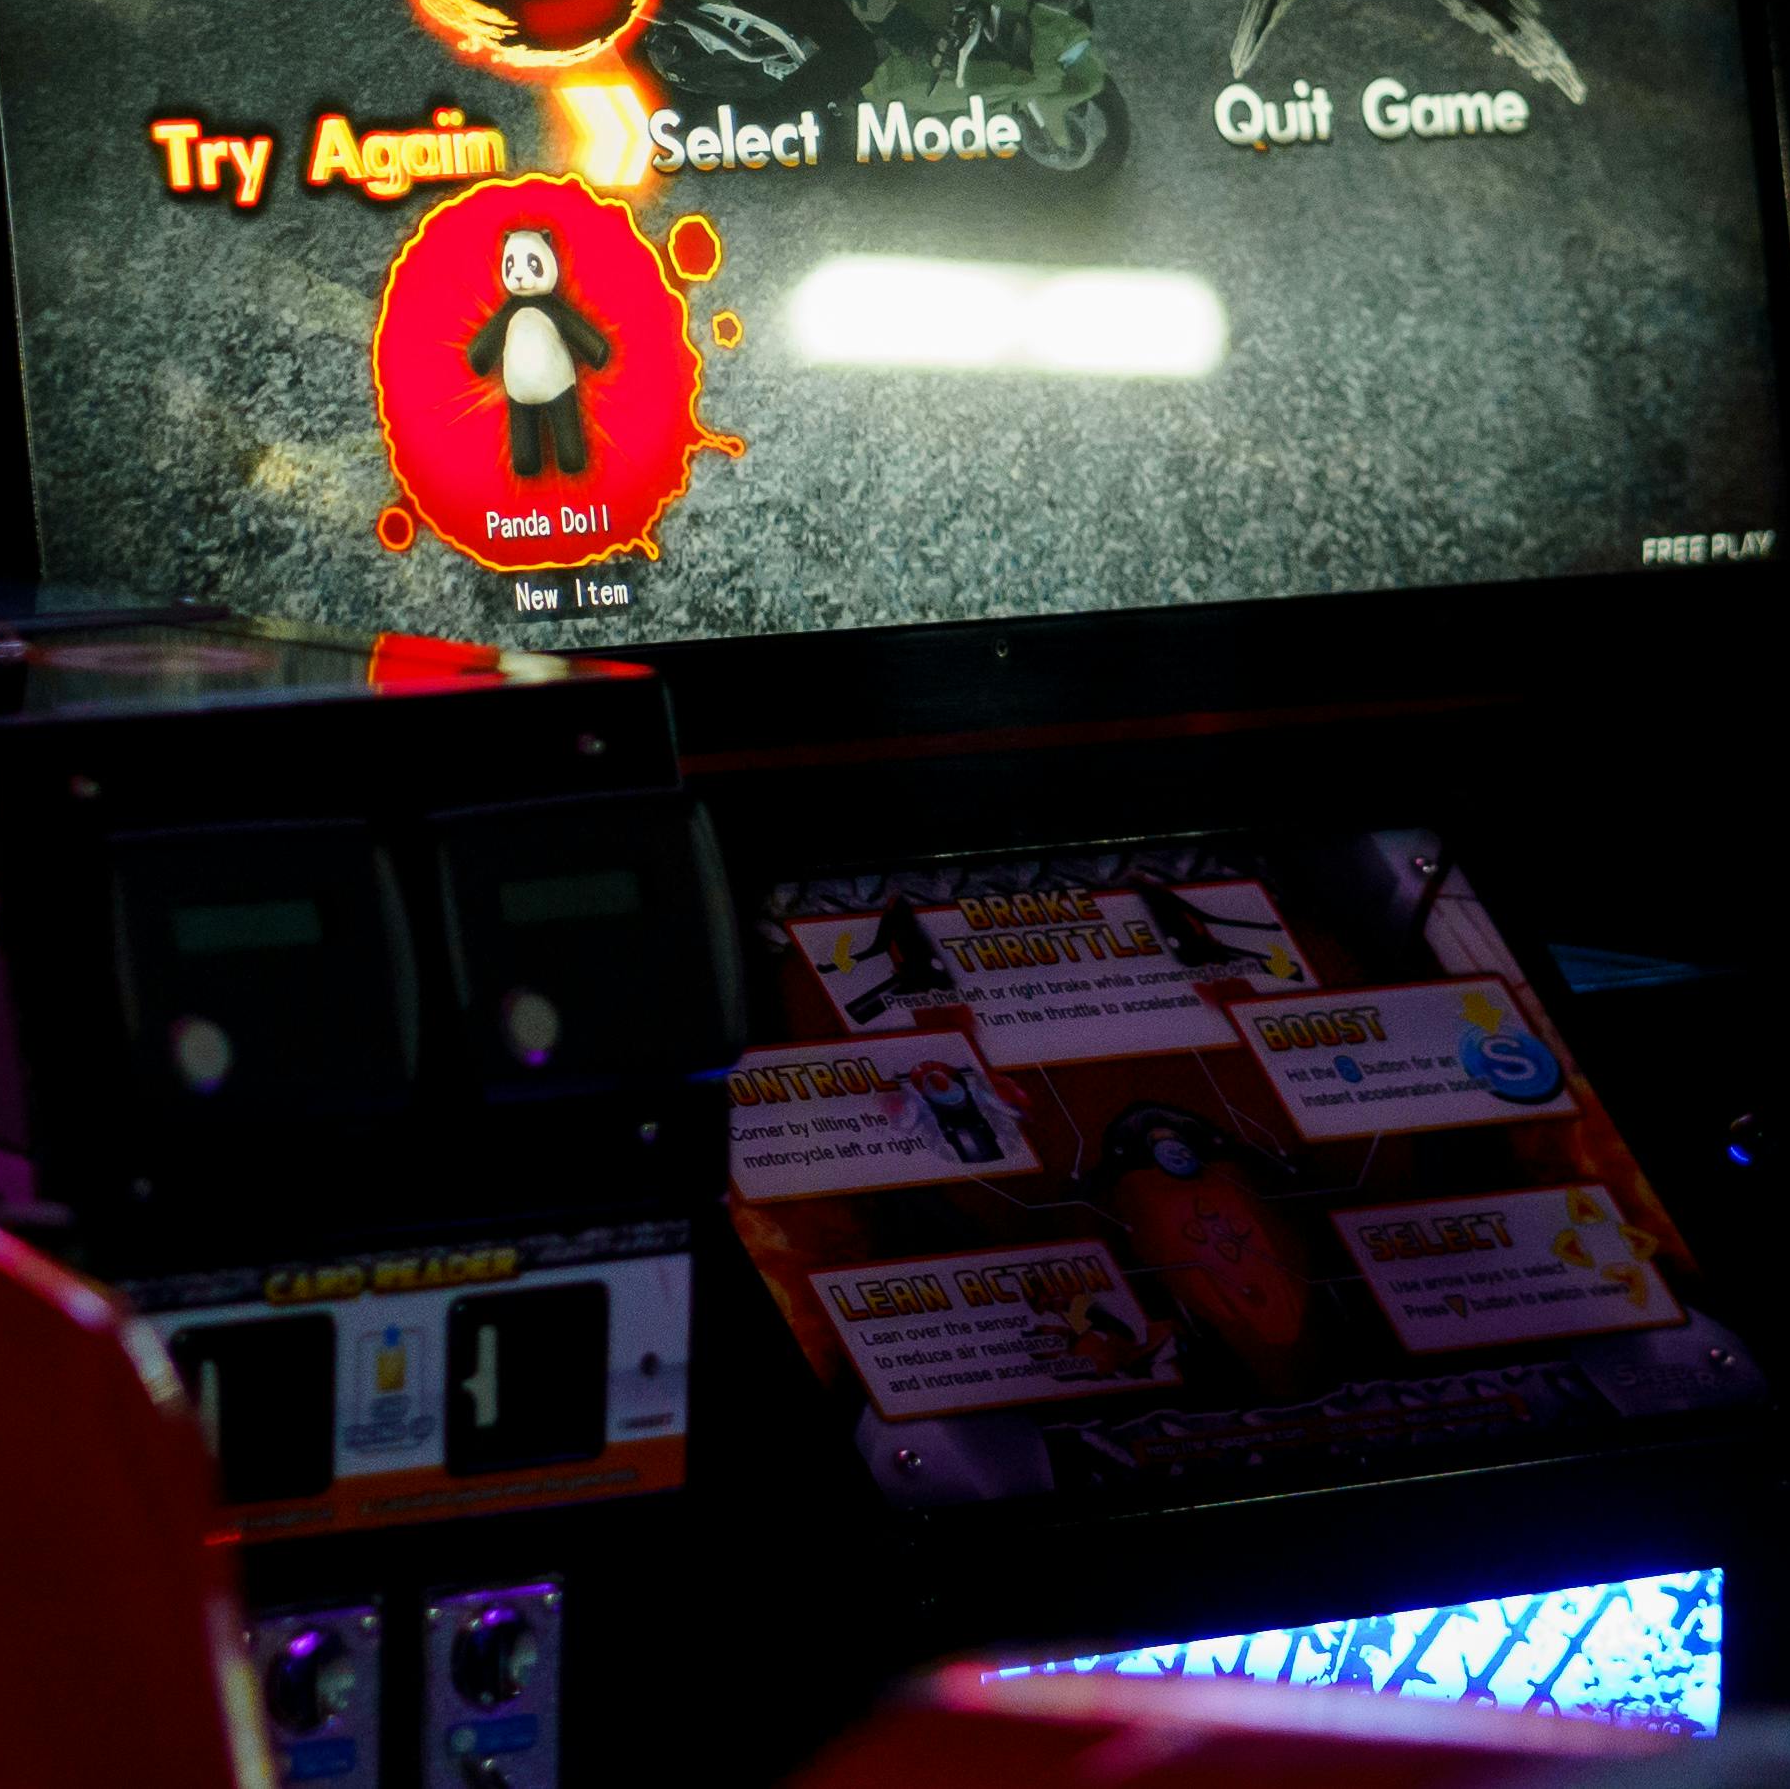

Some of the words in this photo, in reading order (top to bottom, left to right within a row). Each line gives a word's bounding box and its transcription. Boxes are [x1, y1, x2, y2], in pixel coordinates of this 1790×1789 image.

[1214, 78, 1333, 151] Quit
[1361, 76, 1530, 140] Game
[647, 107, 821, 174] Select
[857, 94, 1023, 165] Mode
[153, 116, 271, 207] Try
[308, 106, 508, 197] Again
[485, 508, 552, 540] Panda
[559, 504, 611, 535] Doll
[1642, 533, 1709, 566] FREE
[1711, 529, 1777, 560] PLAY
[514, 580, 559, 612] New
[574, 577, 630, 608] Item
[956, 886, 1105, 931] BRAKE
[942, 920, 1164, 973] THROTTLE
[883, 991, 931, 1012] Press
[962, 986, 988, 1003] left
[1008, 980, 1046, 1002] right
[1046, 976, 1094, 996] brake
[1094, 971, 1134, 990] while
[976, 1010, 1015, 1027] Turn
[1017, 1006, 1043, 1024] the
[1044, 1003, 1100, 1022] throttle
[726, 1056, 901, 1108] ONTROL
[728, 1122, 786, 1142] Corner
[790, 1121, 810, 1138] by
[811, 1114, 861, 1133] tilting
[860, 1111, 889, 1129] the
[743, 1148, 836, 1169] motorcycle
[836, 1142, 861, 1159] left
[866, 1144, 884, 1157] or
[886, 1135, 928, 1156] right
[1358, 1212, 1515, 1262] SELECT
[828, 1273, 954, 1322] LEAN
[953, 1254, 1117, 1307] ACTION
[859, 1329, 904, 1347] Lean
[905, 1325, 943, 1342] over
[943, 1320, 973, 1338] the
[973, 1313, 1032, 1333] sensor
[875, 1353, 895, 1370] to
[895, 1347, 954, 1368] reduce
[956, 1342, 979, 1360] air
[888, 1376, 923, 1394] and
[923, 1368, 995, 1390] increase
